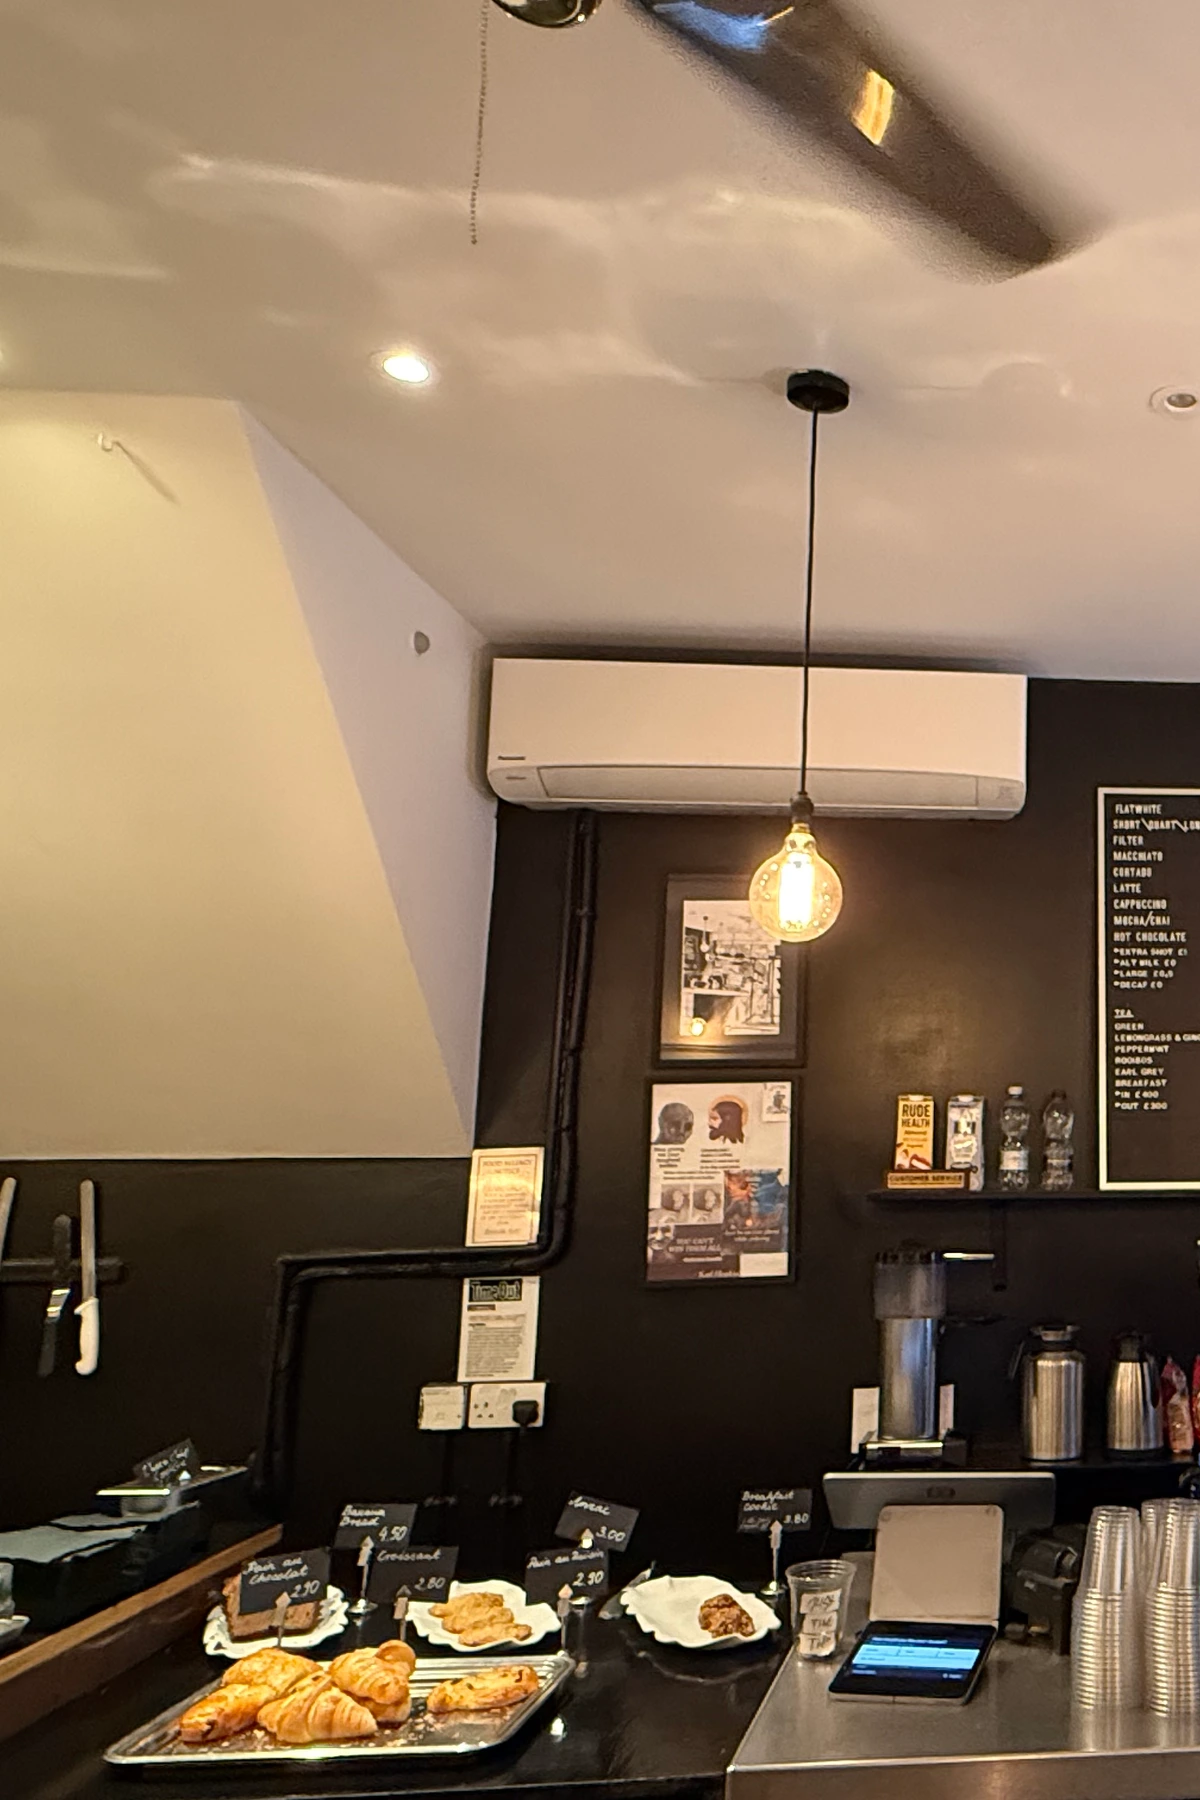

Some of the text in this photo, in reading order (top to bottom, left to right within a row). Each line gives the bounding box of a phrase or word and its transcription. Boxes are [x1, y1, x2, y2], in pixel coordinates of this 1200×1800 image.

[1113, 835, 1144, 846] FILTER
[1113, 851, 1163, 861] MACCHIATO
[1113, 867, 1152, 878] CORTADO
[1113, 883, 1141, 893] LATTE
[1113, 899, 1167, 910] CAPPUCCINO
[1113, 932, 1132, 942] HOT
[1136, 932, 1187, 942] CHOCOLATE
[1114, 1009, 1134, 1018] TEA
[1114, 1023, 1144, 1031] GREEN
[1114, 1034, 1172, 1042] LEMONGRASS
[1114, 1045, 1170, 1053] PEPPERMINT
[1114, 1068, 1164, 1076] EARL GREY
[1114, 1079, 1167, 1087] BREAKFAST
[902, 1103, 931, 1118] RUDE
[901, 1118, 931, 1128] HEALTH
